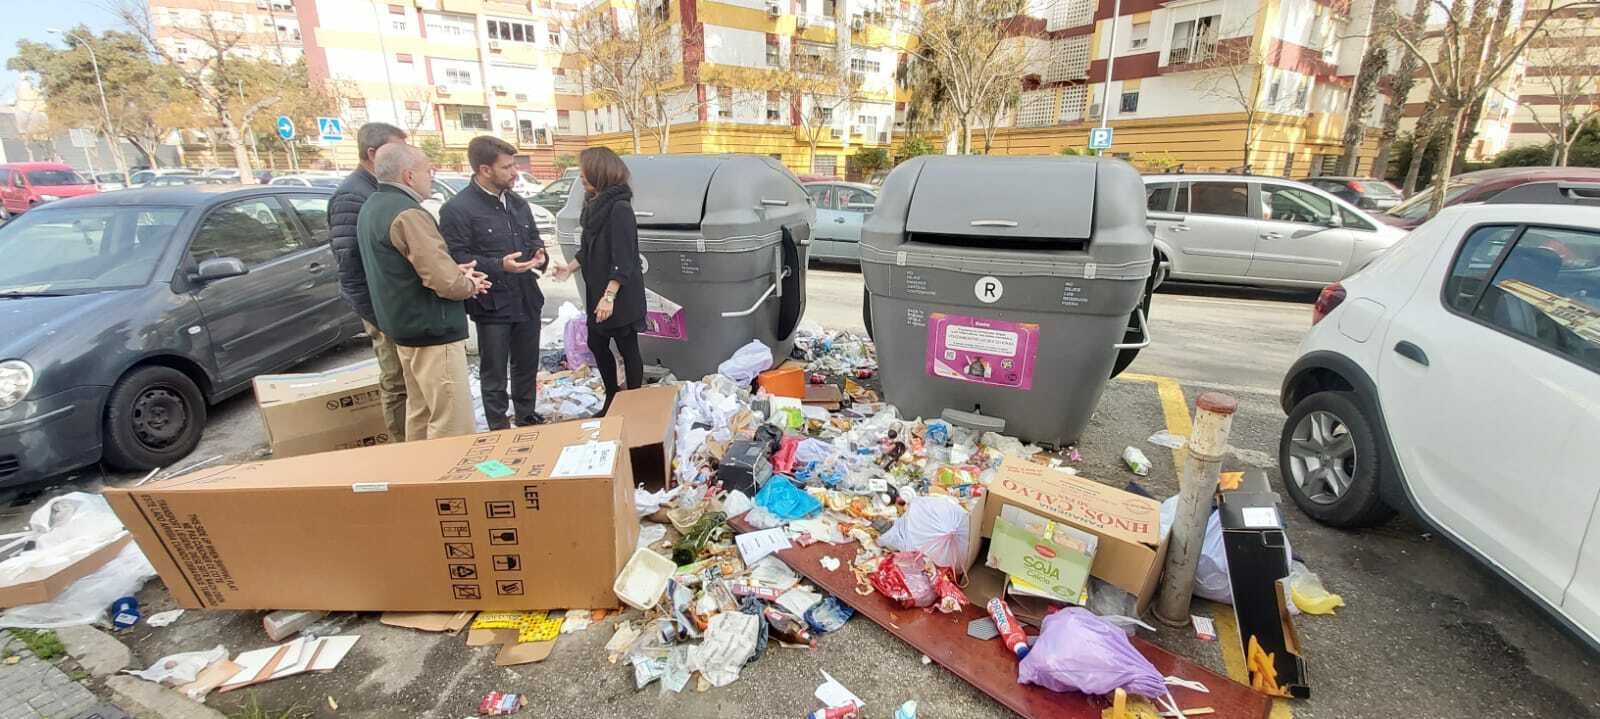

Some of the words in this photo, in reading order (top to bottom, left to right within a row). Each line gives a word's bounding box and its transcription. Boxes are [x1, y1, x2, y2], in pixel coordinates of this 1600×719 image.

[1095, 131, 1108, 146] P
[984, 282, 996, 298] R
[524, 485, 540, 511] LEFT
[1002, 479, 1073, 511] CALVO
[1023, 555, 1060, 581] SOJA
